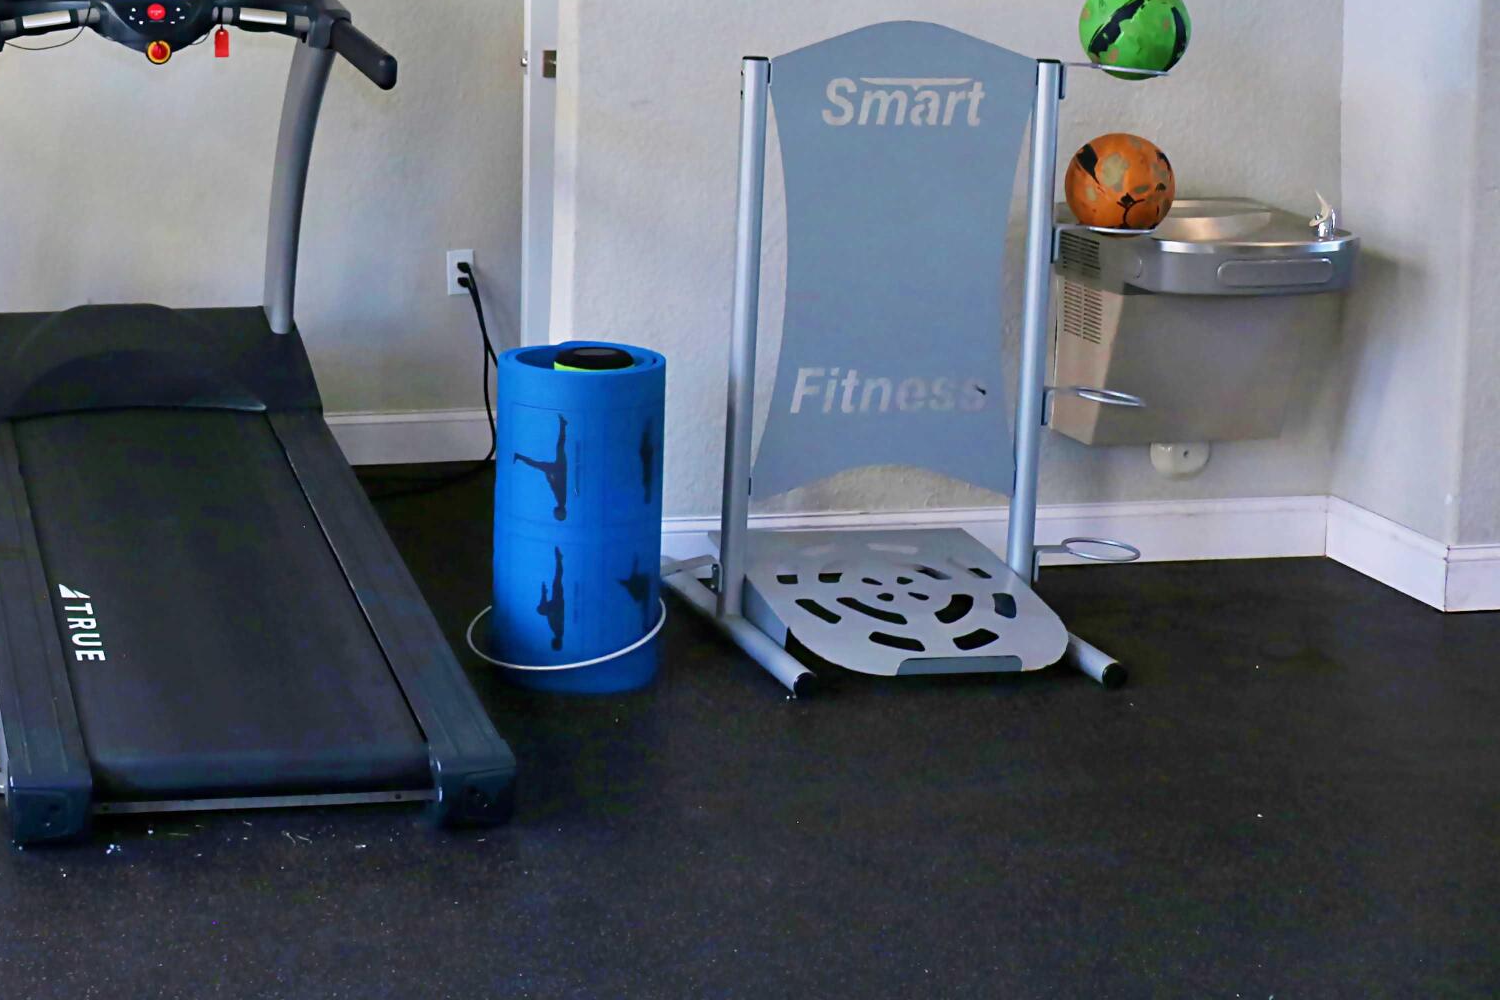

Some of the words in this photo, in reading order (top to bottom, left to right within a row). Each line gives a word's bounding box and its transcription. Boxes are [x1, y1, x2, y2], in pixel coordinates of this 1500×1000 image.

[822, 77, 985, 127] Smart
[790, 367, 988, 414] Fitness
[64, 602, 106, 661] TRUE
